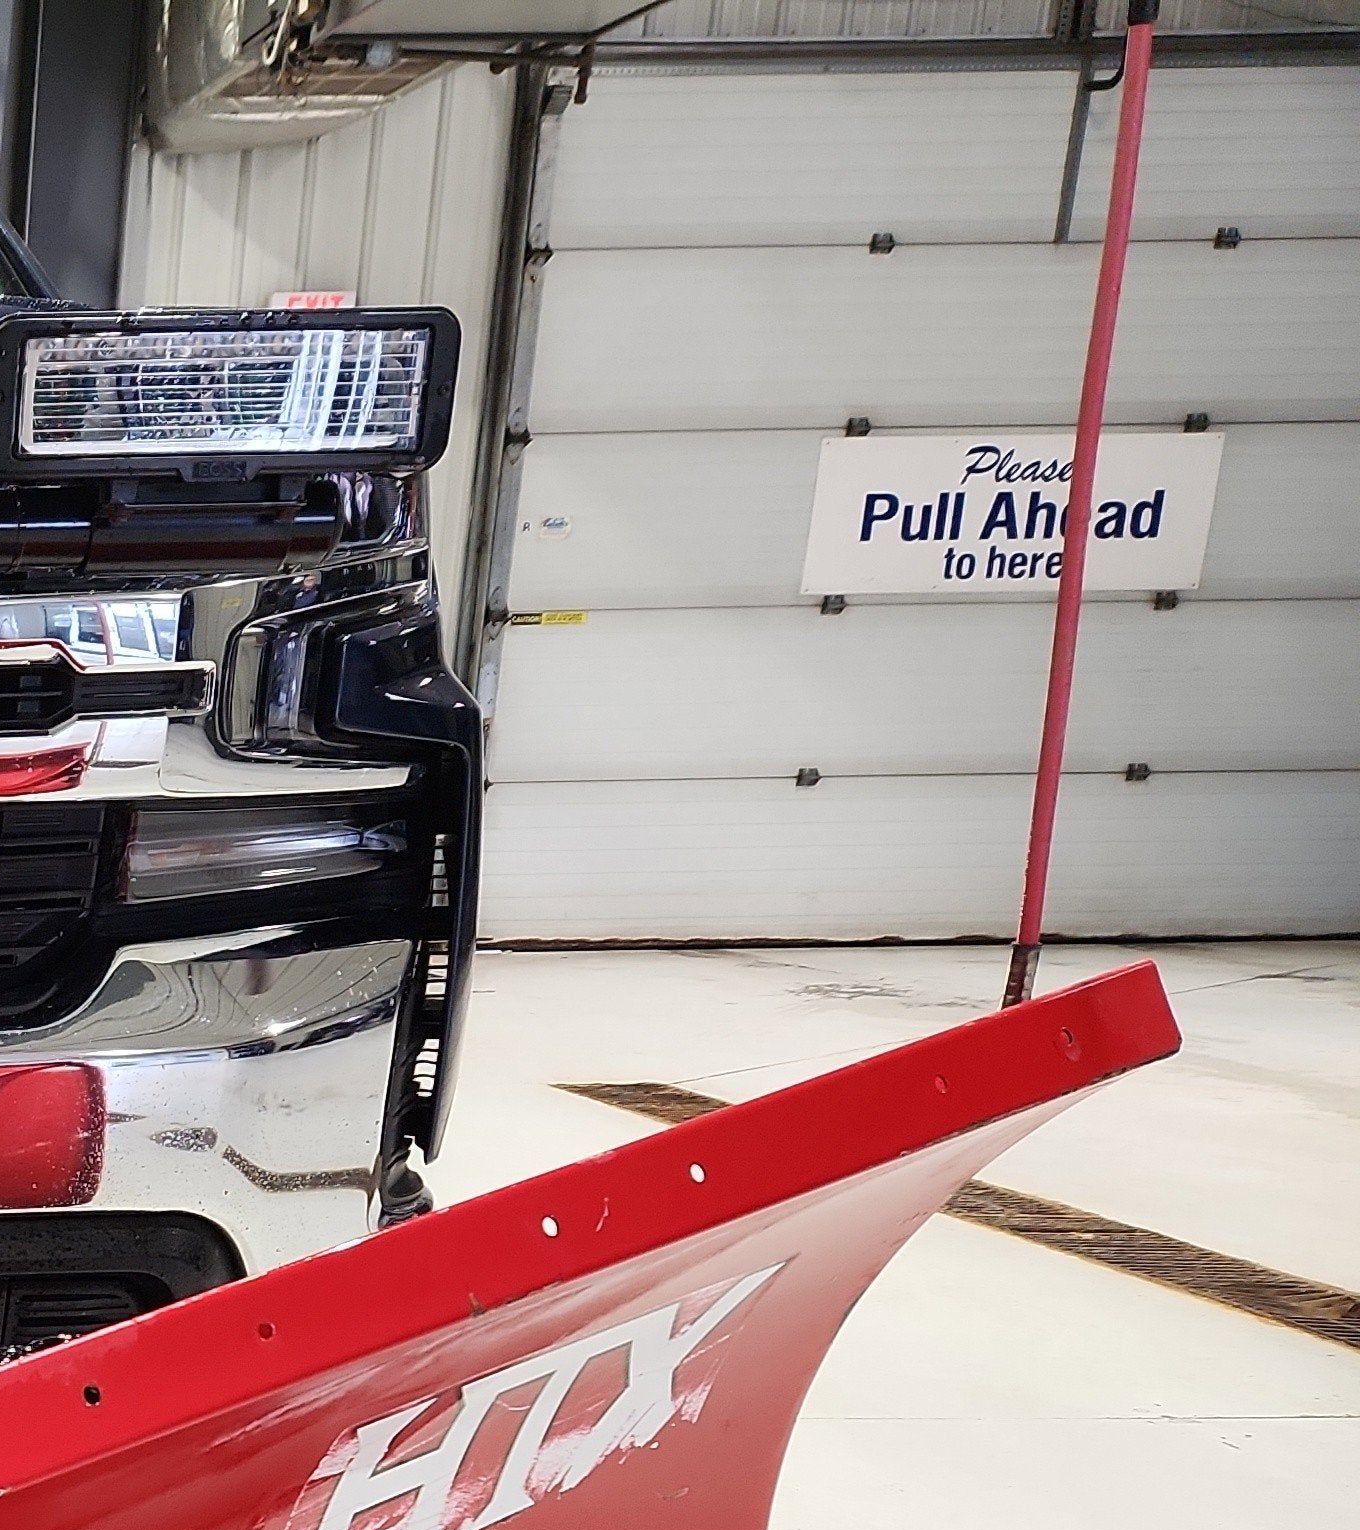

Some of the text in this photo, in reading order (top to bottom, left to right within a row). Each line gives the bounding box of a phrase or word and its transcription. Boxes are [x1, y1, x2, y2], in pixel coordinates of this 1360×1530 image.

[961, 445, 1073, 484] Please
[859, 491, 966, 542] Pull
[943, 545, 1063, 580] to here
